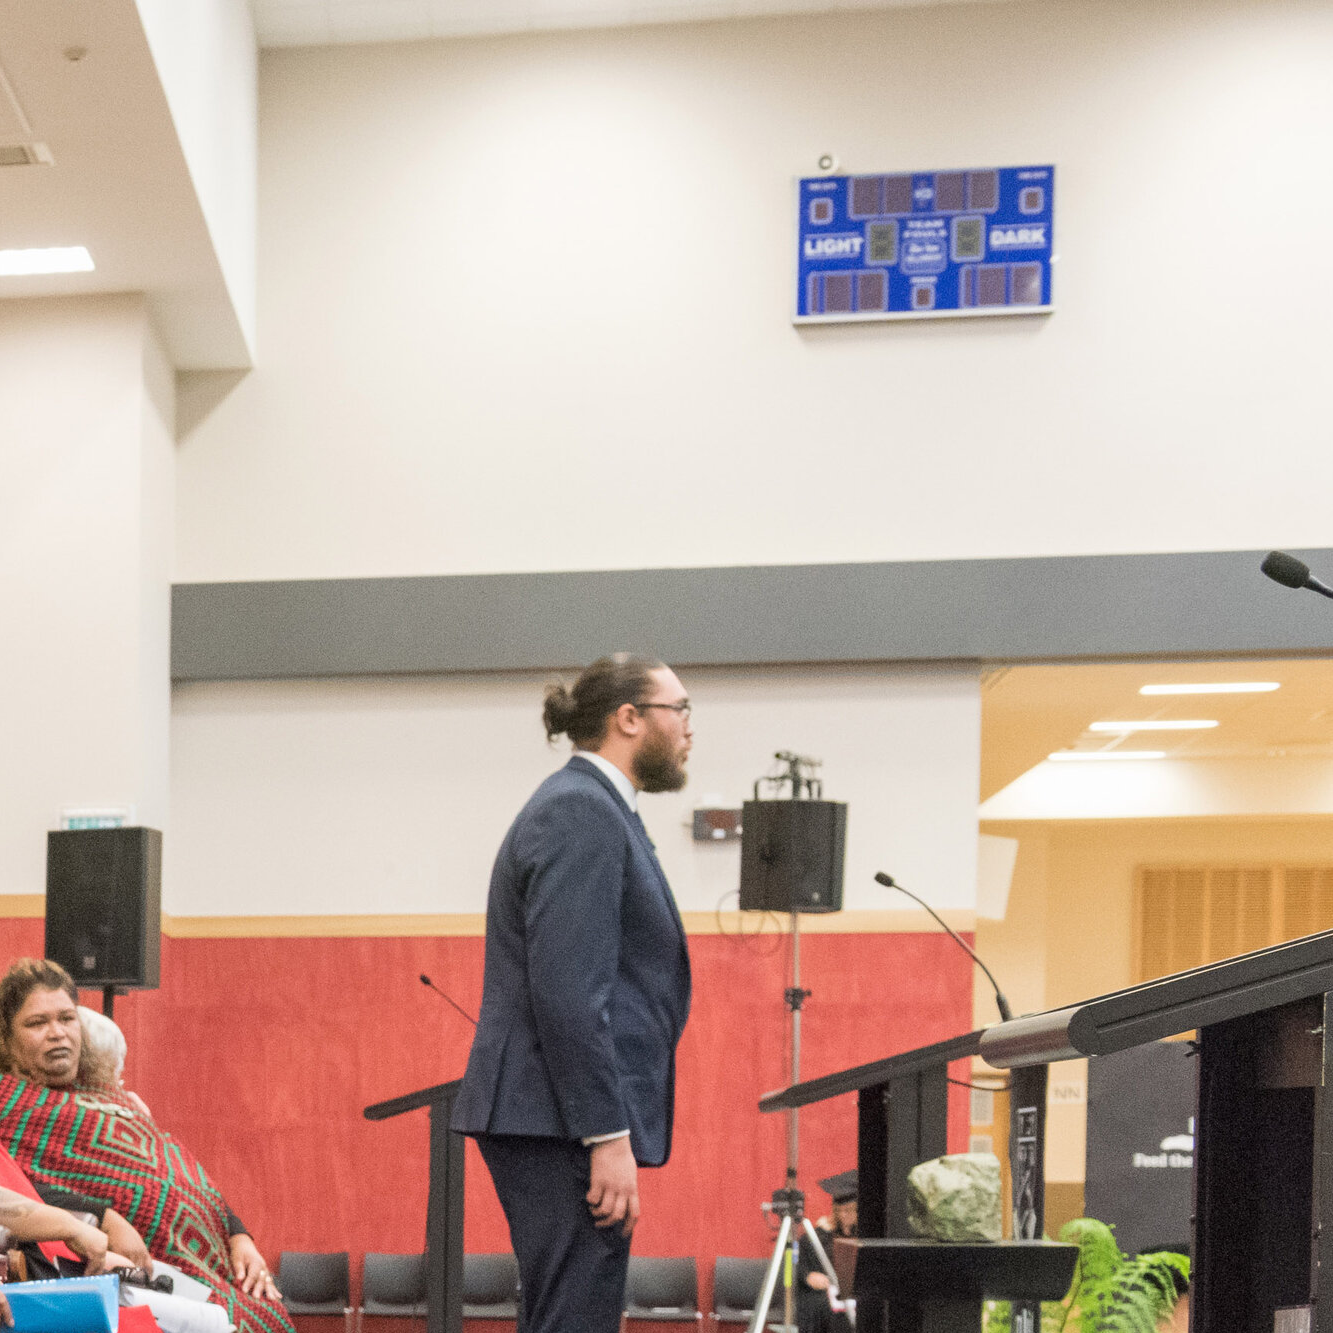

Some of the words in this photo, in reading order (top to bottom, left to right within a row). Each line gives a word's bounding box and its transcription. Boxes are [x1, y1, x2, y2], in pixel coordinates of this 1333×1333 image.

[989, 228, 1047, 247] DARK
[804, 237, 864, 258] LIGHT
[1133, 1152, 1167, 1168] Feed
